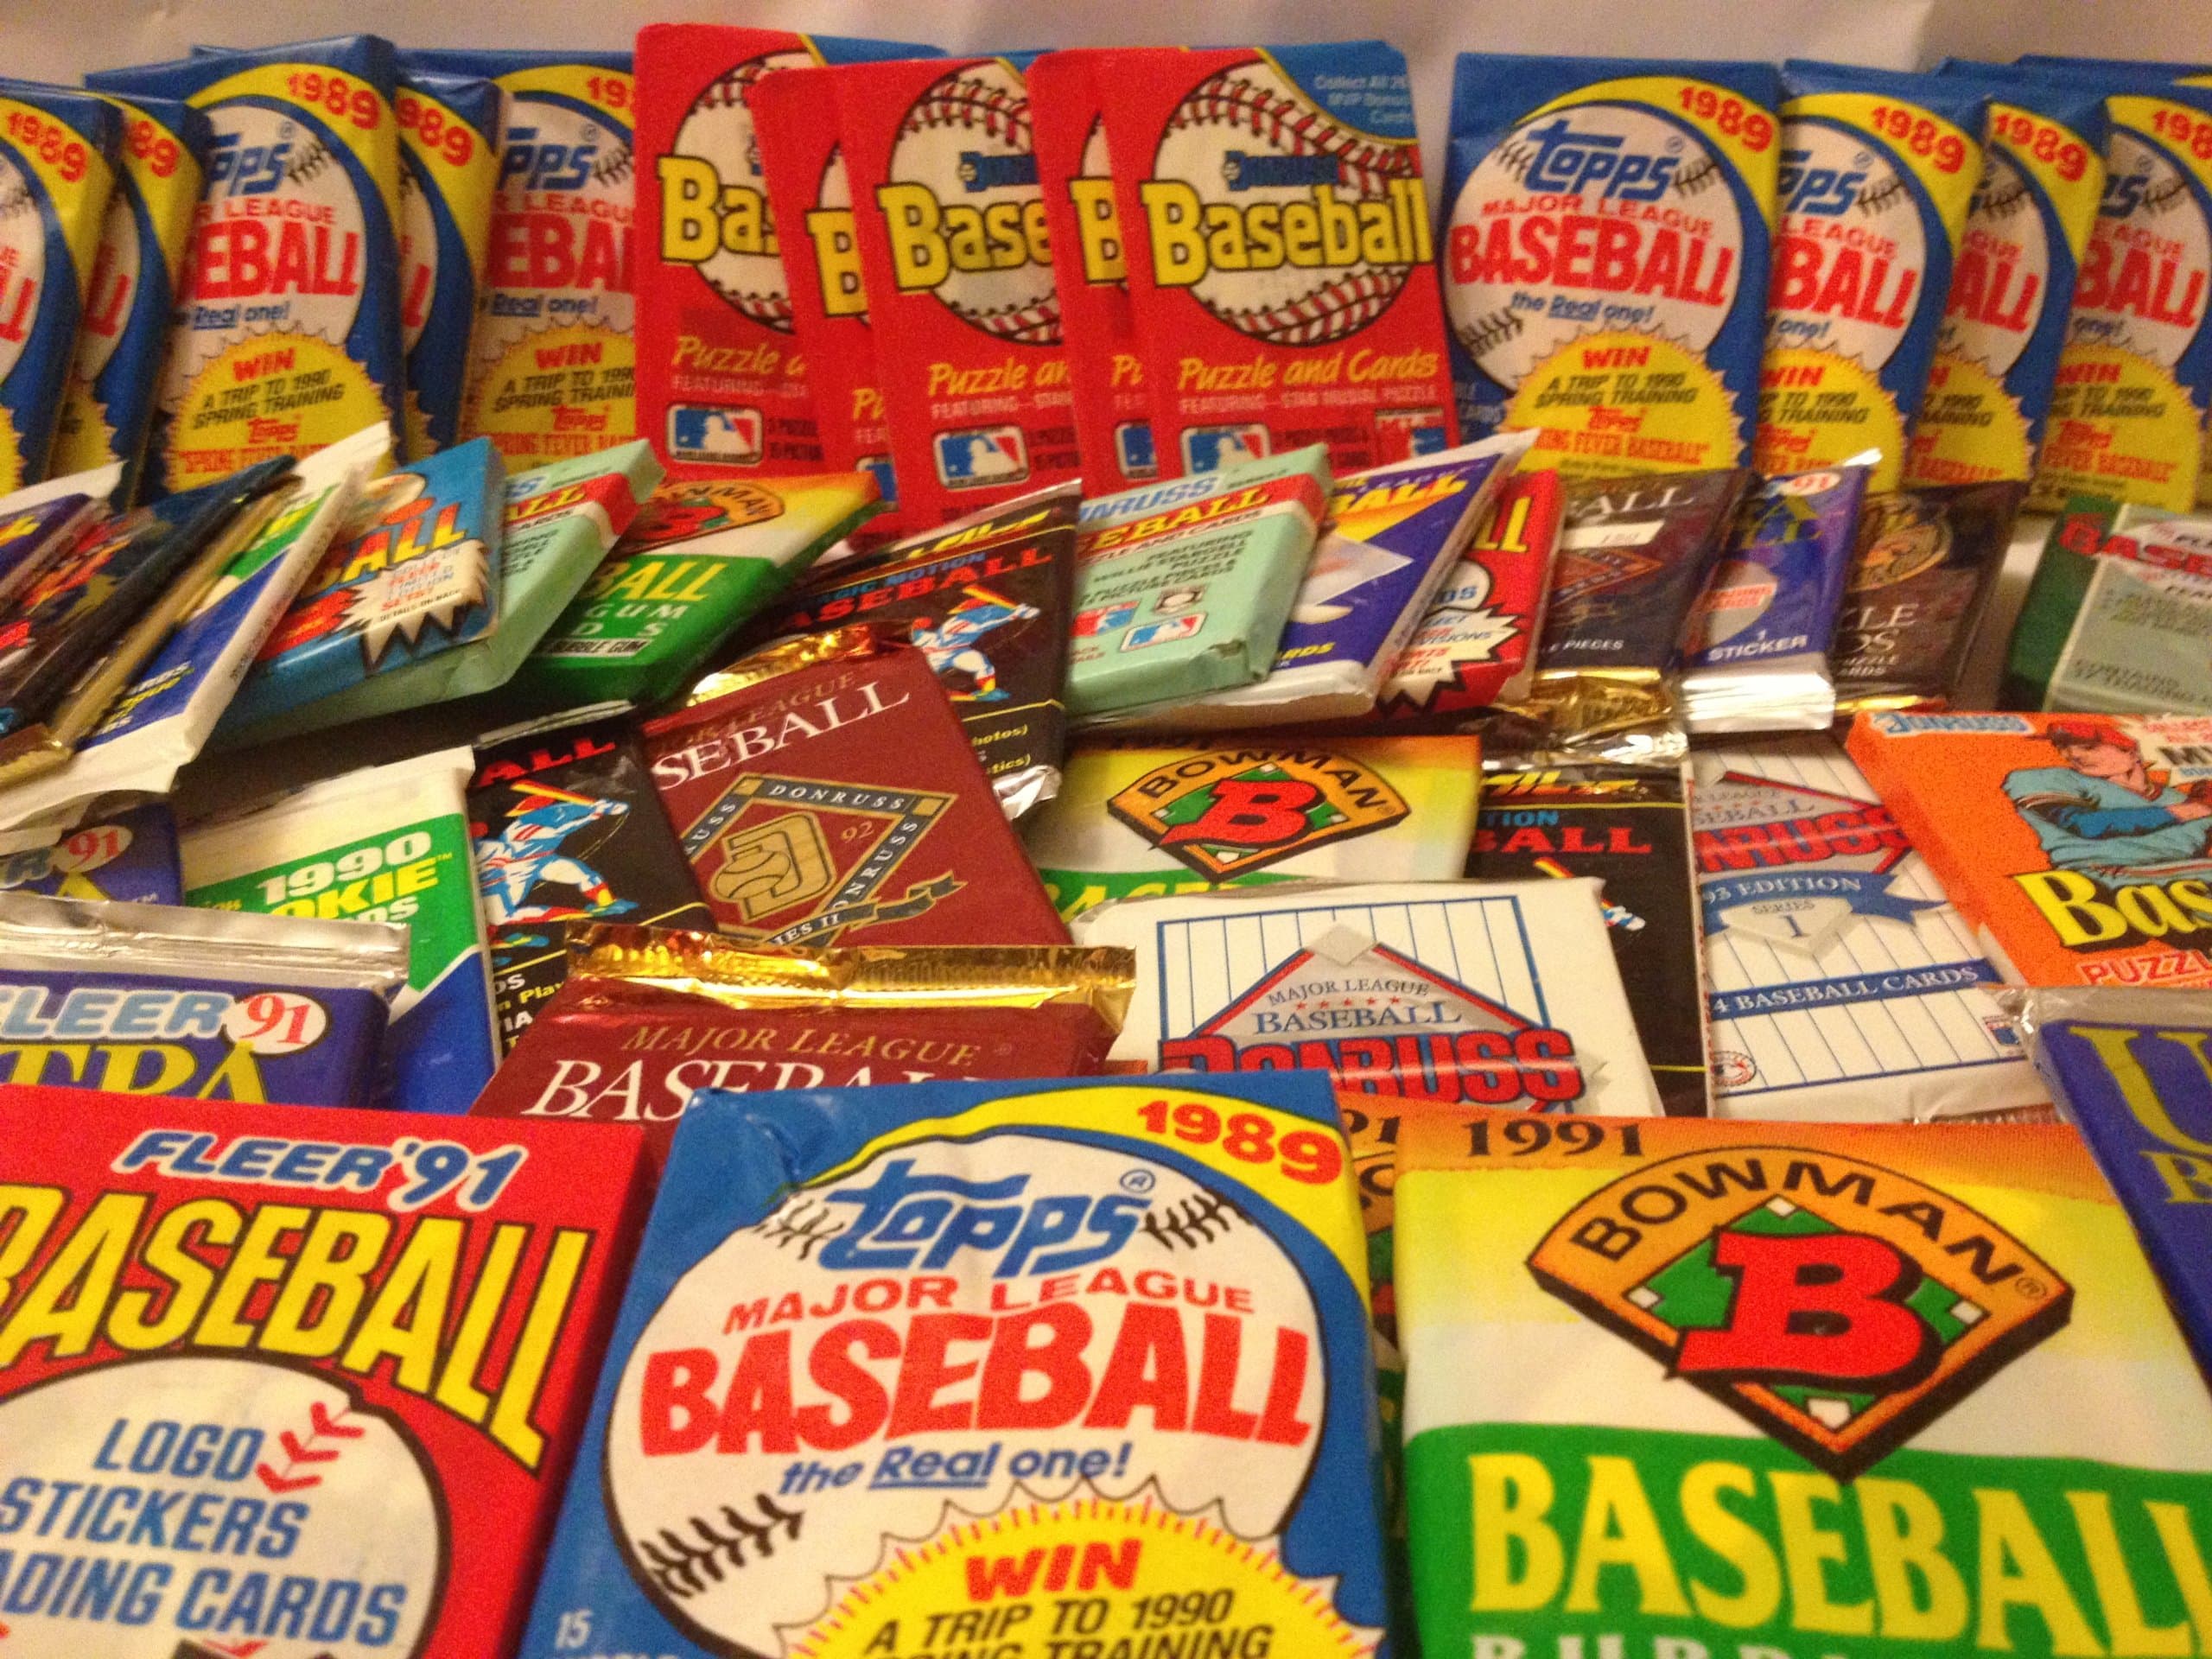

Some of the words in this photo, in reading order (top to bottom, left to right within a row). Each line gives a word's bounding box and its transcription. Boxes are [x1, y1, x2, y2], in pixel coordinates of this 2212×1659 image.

[287, 73, 381, 130] 1989
[1677, 86, 1774, 152] 1989
[7, 112, 88, 182] 1989
[1872, 106, 1966, 174] 1989
[1995, 113, 2088, 181] 1989
[224, 198, 336, 226] LEAGUE
[1140, 176, 1433, 287] Baseball
[1481, 193, 1582, 218] MAJOR
[1599, 199, 1714, 238] LEAGUE
[1448, 214, 1735, 308] BASEBALL
[1511, 291, 1544, 312] the
[232, 347, 296, 382] WIN
[671, 334, 780, 375] Puzzle
[927, 355, 1029, 396] Puzzle
[1178, 354, 1277, 391] Puzzle
[1283, 350, 1344, 385] and
[1347, 347, 1440, 383] Cards
[1582, 346, 1652, 370] WIN
[1567, 374, 1609, 390] TRIP
[1614, 373, 1638, 389] TO
[1644, 372, 1687, 388] 1990
[1609, 387, 1699, 405] TRAINING
[1562, 639, 1624, 651] PIECES
[1707, 634, 1808, 662] STICKER
[650, 681, 911, 791] SEBALL
[768, 783, 906, 810] DONRUSS
[1138, 747, 1389, 810] BOWMAN
[67, 830, 121, 867] 91
[840, 820, 874, 845] 92
[260, 830, 432, 902] 1990
[1736, 875, 1863, 898] EDITION
[1751, 899, 1816, 913] SERIES
[1267, 980, 1337, 1007] MAJOR
[1343, 977, 1430, 997] LEAGUE
[1734, 978, 1878, 1011] BASEBALL
[1883, 966, 1980, 994] CARDS
[240, 994, 309, 1046] 91
[1254, 1001, 1463, 1036] BASEBALL
[620, 1025, 779, 1055] MAJOR
[787, 1027, 982, 1067] LEAGUE
[1136, 1099, 1343, 1185] 1989
[1466, 1117, 1645, 1158] 1991
[1570, 1156, 2021, 1286] BOWMAN
[722, 1275, 958, 1336] MAJOR
[989, 1267, 1255, 1313] LEAGUE
[1672, 1230, 1927, 1381] B
[639, 1300, 1314, 1459] BASEBALL
[93, 1418, 265, 1483] LOGO
[778, 1460, 861, 1497] the
[868, 1440, 1002, 1489] Real
[1009, 1440, 1134, 1479] one!
[0, 1477, 310, 1560] STICKERS
[965, 1536, 1143, 1603] WIN
[177, 1567, 407, 1648] CARDS
[555, 1610, 593, 1649] 15
[866, 1619, 900, 1656] A
[923, 1603, 1034, 1648] TRIP
[1051, 1597, 1111, 1636] TO
[1130, 1587, 1235, 1630] 1990
